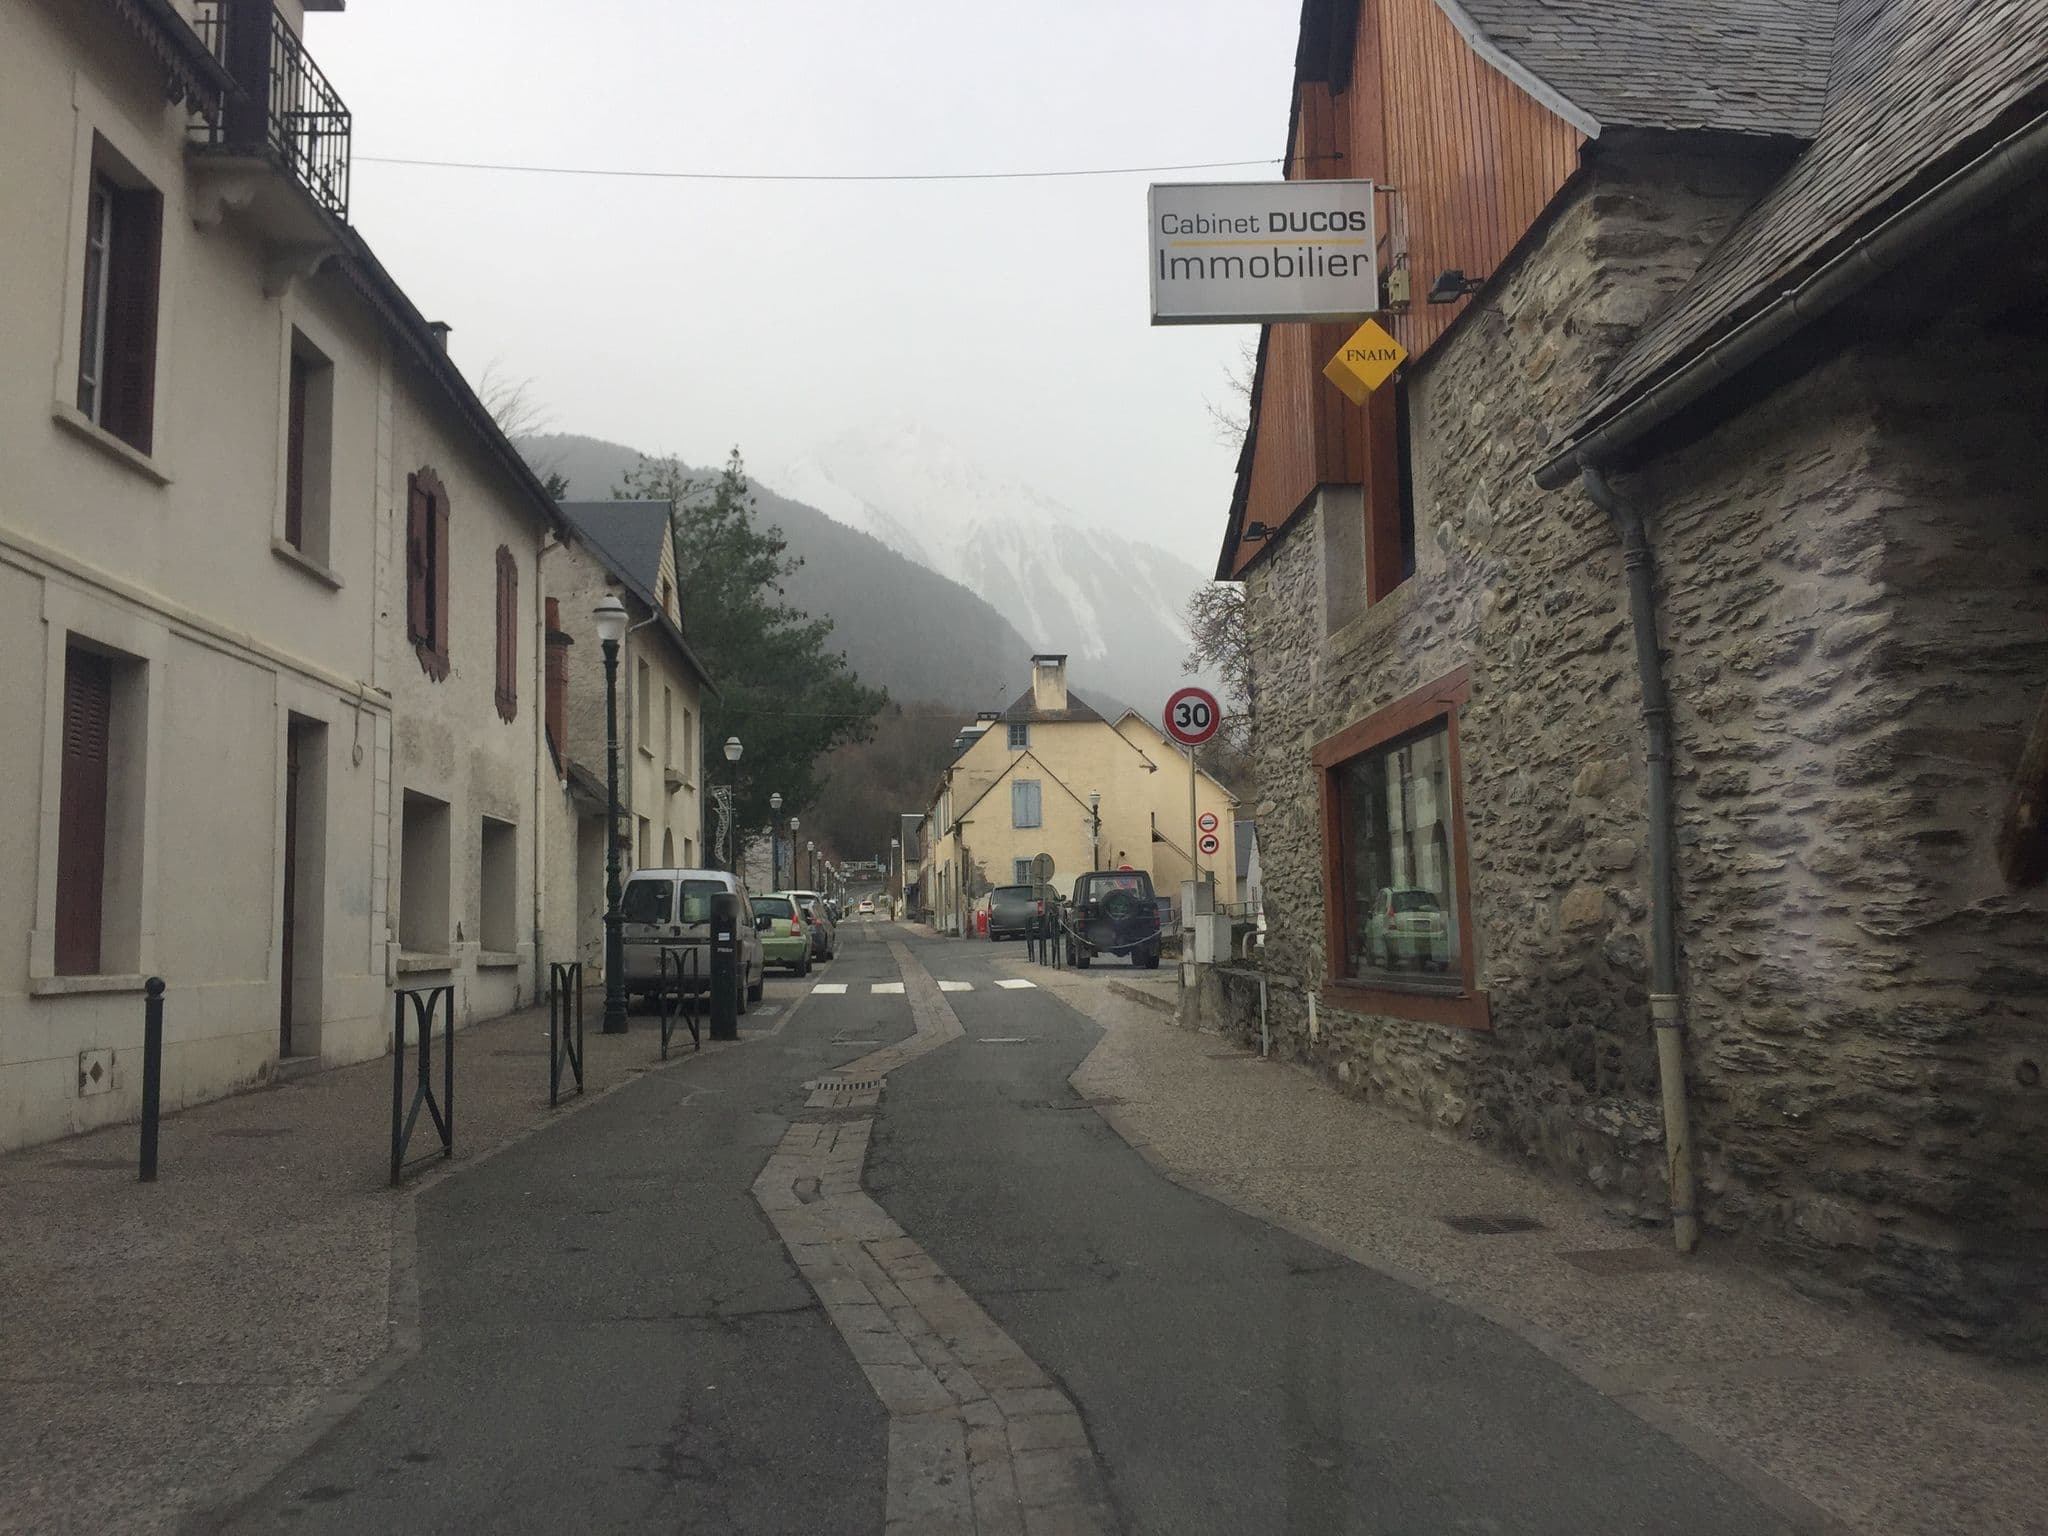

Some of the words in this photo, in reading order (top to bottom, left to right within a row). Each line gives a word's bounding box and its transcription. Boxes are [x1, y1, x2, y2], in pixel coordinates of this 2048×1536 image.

[1161, 213, 1260, 235] Cabinet
[1269, 211, 1366, 232] DUCOS
[1159, 247, 1369, 280] Immobilier
[1346, 349, 1397, 361] FNAIM
[1175, 703, 1210, 728] 30
